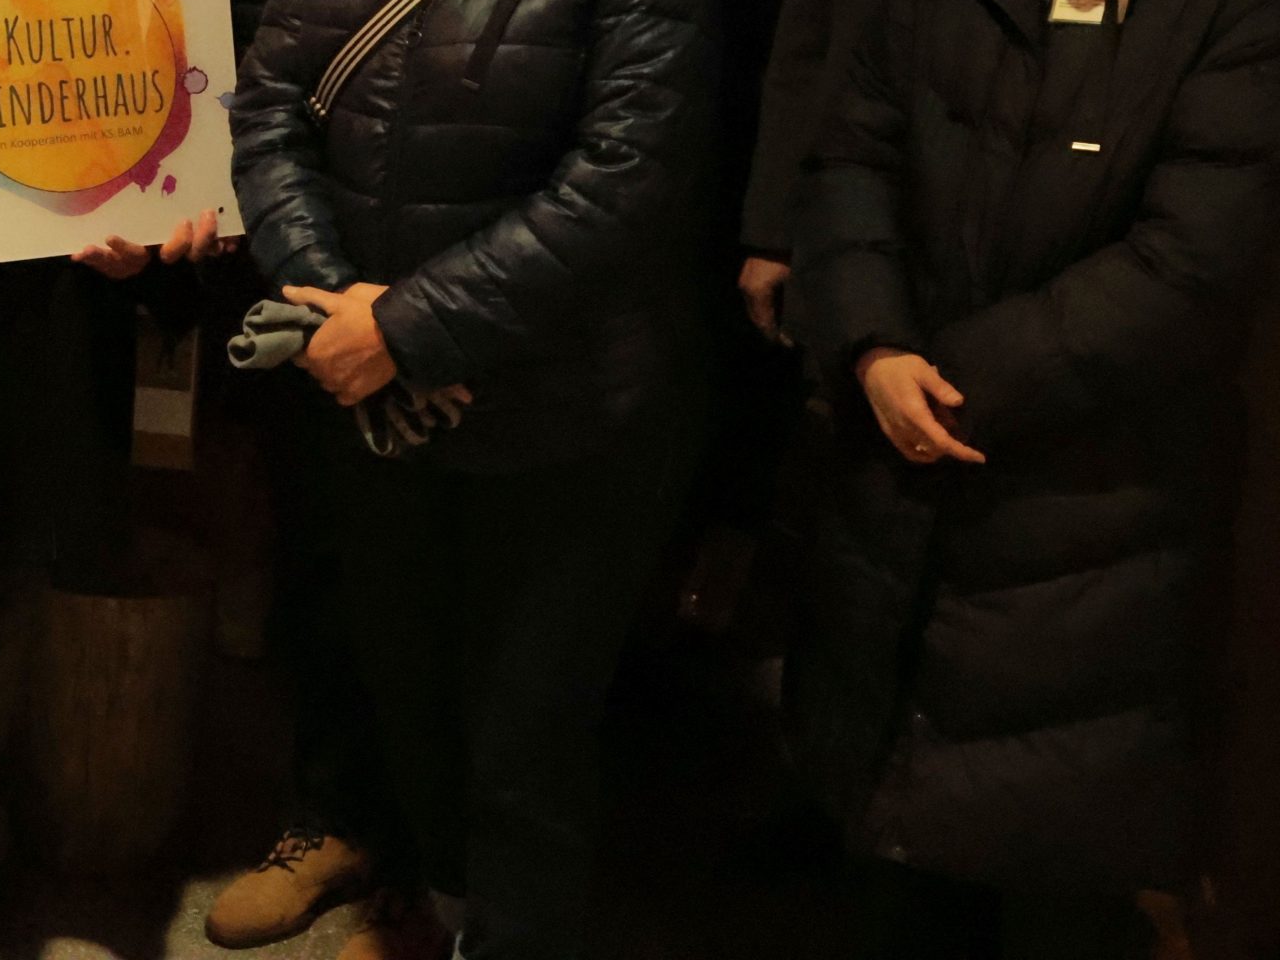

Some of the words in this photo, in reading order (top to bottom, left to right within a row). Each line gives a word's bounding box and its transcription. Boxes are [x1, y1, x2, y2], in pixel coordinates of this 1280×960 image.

[4, 14, 130, 65] KULTUR.
[10, 134, 77, 149] Kooperation
[82, 132, 97, 140] mit
